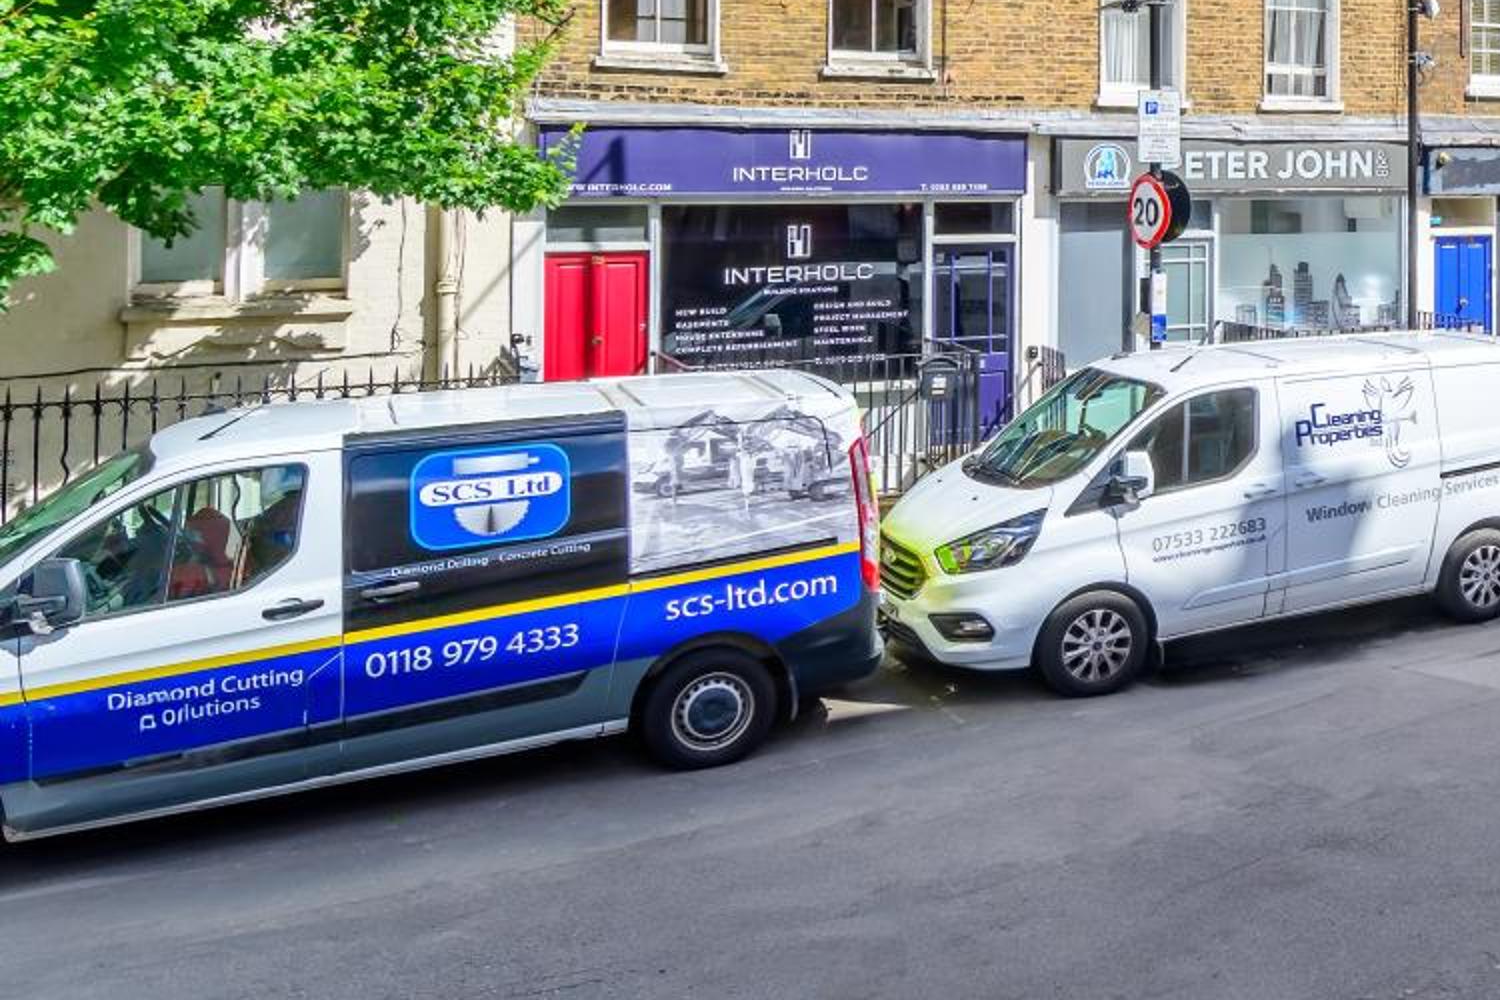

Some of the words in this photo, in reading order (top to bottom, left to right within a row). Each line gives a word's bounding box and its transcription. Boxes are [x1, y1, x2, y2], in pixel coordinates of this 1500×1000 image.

[733, 166, 868, 182] INTERHOLC
[1278, 150, 1373, 179] JOHN
[1133, 197, 1159, 227] 20
[724, 262, 874, 285] INTERHOLC
[1310, 403, 1382, 428] Cleaning
[431, 481, 494, 503] SCS
[507, 476, 551, 496] Ltd
[1306, 501, 1372, 522] Window
[1376, 487, 1442, 511] Cleaning
[1445, 474, 1500, 495] Services
[1152, 529, 1204, 553] 07533
[1209, 517, 1267, 542] 222683
[391, 561, 446, 578] Diamond
[499, 549, 549, 562] Concrete
[664, 574, 838, 621] scs-ltd.com
[364, 645, 433, 679] 0118
[442, 635, 498, 668] 979
[505, 623, 580, 655] 4333
[106, 678, 216, 712] Diamond
[220, 668, 305, 694] Cutting
